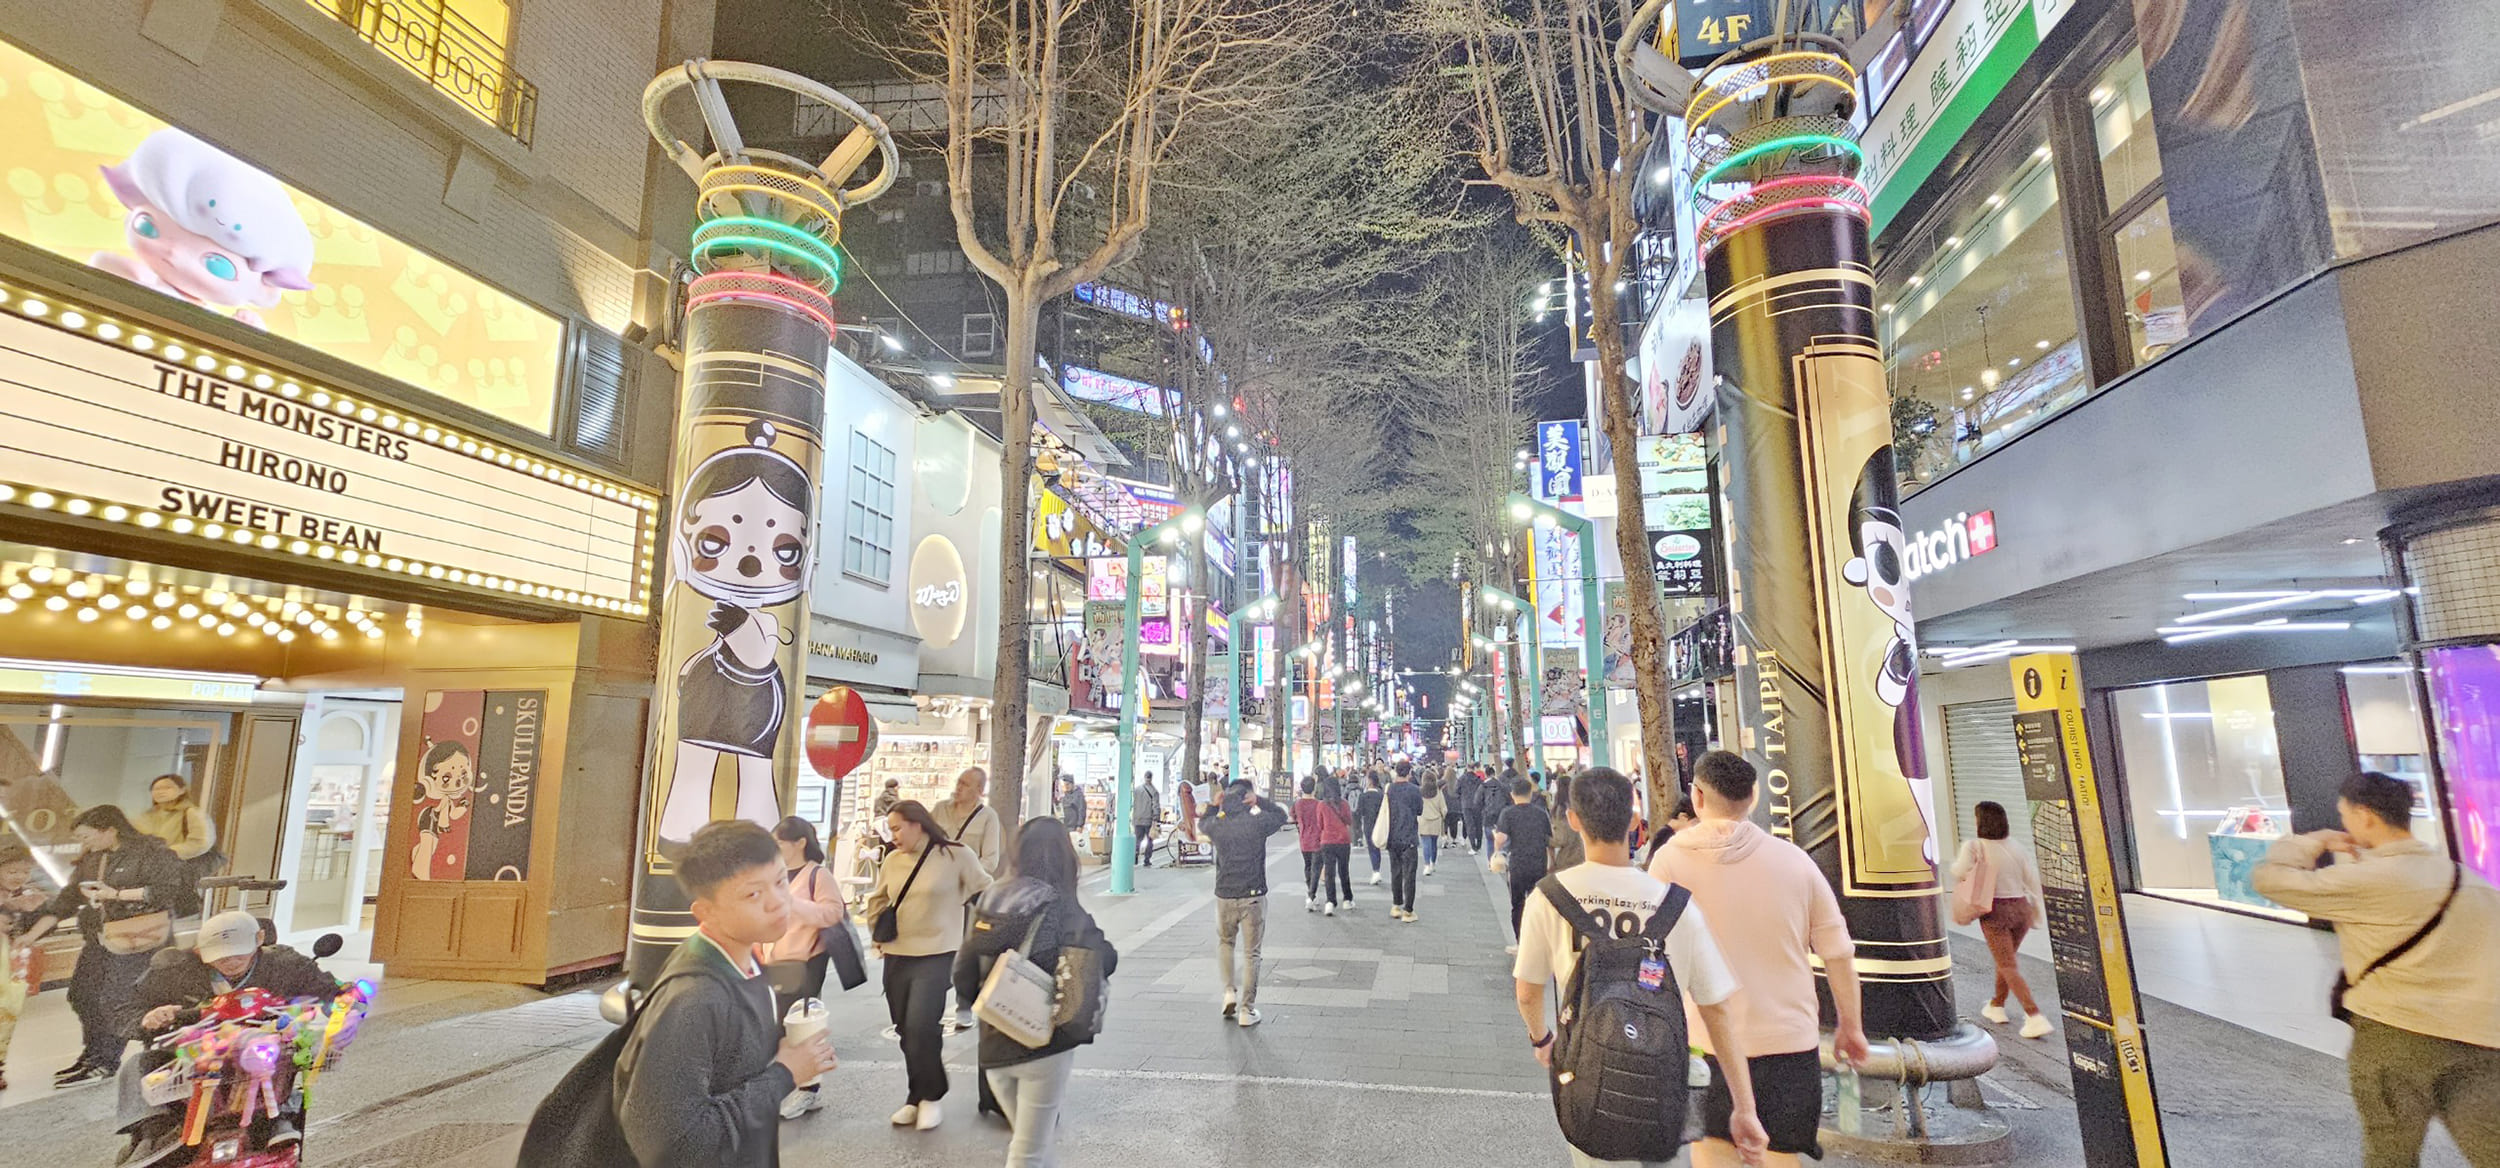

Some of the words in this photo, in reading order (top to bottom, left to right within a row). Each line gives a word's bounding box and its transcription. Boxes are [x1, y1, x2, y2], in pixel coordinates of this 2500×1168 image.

[1697, 14, 1751, 45] 4F
[153, 364, 229, 411] THE
[239, 391, 411, 462] MONSTERS
[219, 441, 349, 495] HIRONO
[159, 486, 291, 535] SWEET
[300, 515, 383, 552] BEAN
[1756, 648, 1787, 760] TAIPEI
[2065, 709, 2078, 749] TOURIST
[503, 697, 538, 828] SKULLPANDA
[1767, 769, 1793, 844] LLO
